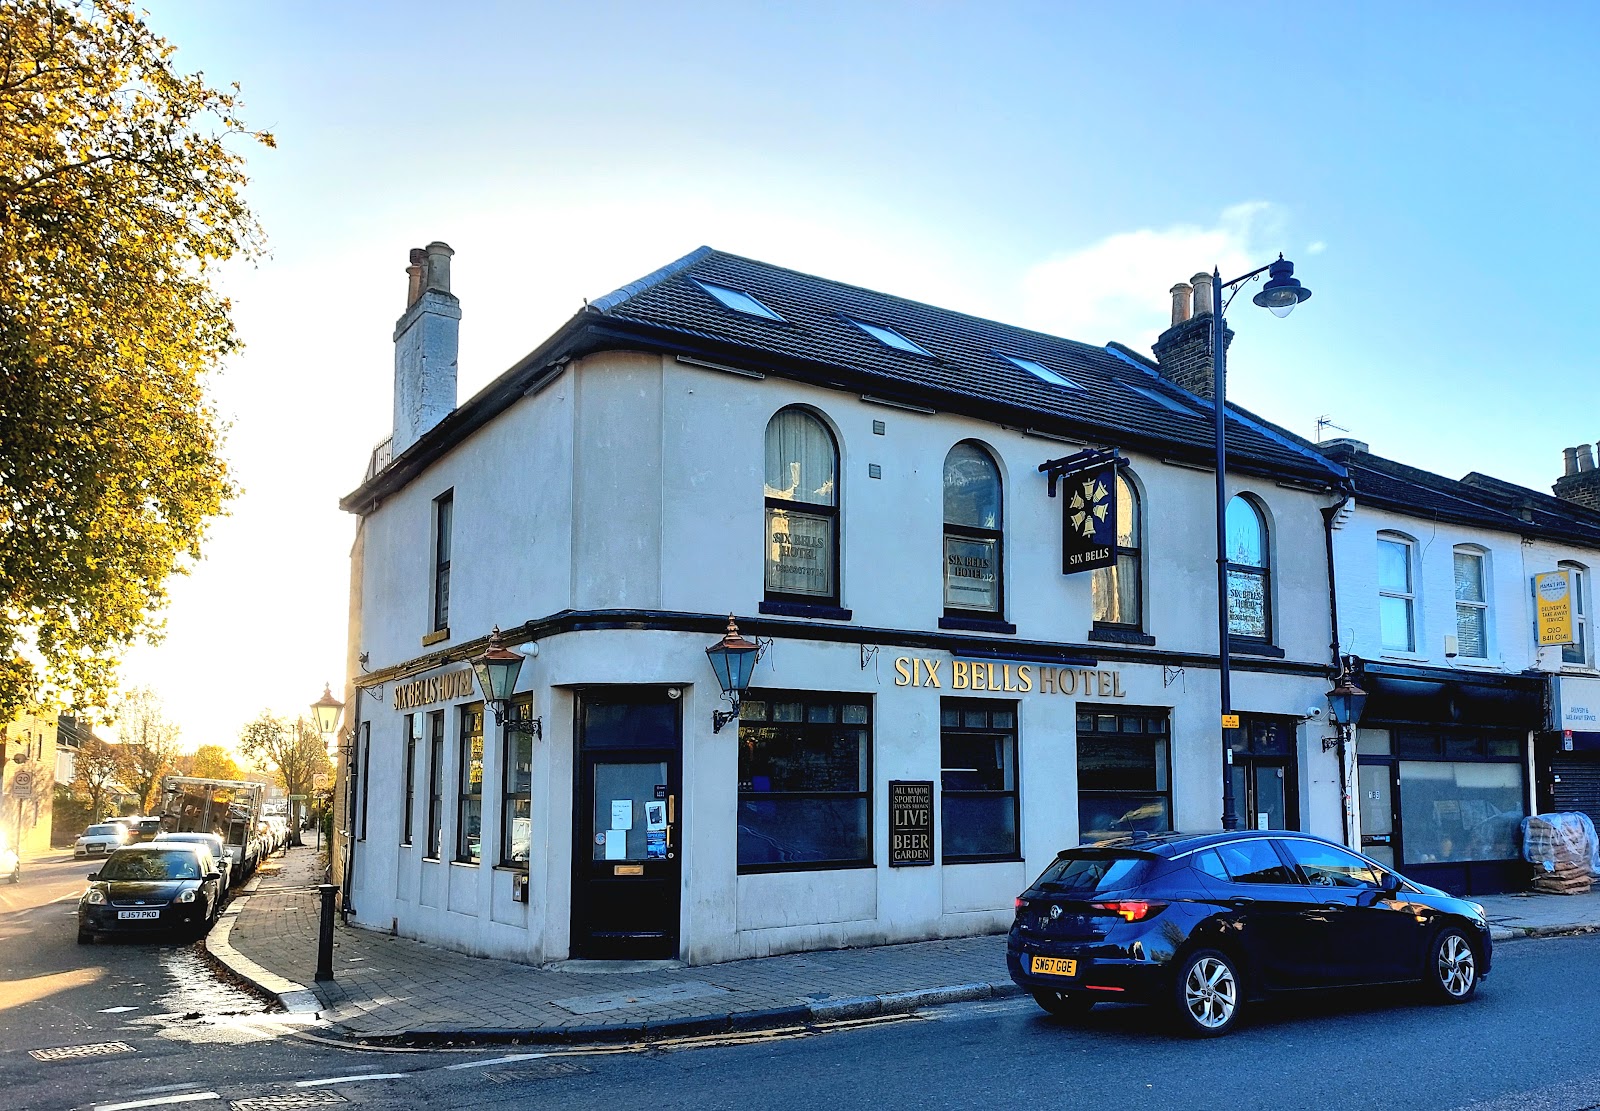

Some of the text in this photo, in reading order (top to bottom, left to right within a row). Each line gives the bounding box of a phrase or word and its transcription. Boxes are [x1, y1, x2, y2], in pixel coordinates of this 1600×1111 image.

[772, 532, 825, 549] SIX BELLS
[779, 545, 817, 560] HOTEL
[1069, 548, 1109, 565] SIX BELLS
[948, 554, 990, 568] SIX BELLS
[955, 566, 984, 580] HOTEL
[1541, 605, 1562, 613] DELIVERY
[894, 657, 1127, 698] SIX BELLS HOTEL
[393, 667, 475, 710] SIX BELLS HOTEL
[894, 786, 928, 796] ALL MAJOR
[894, 796, 929, 804] SPORTING
[895, 810, 928, 826] LIVE
[894, 834, 929, 849] BEER
[894, 849, 929, 860] GARDEN
